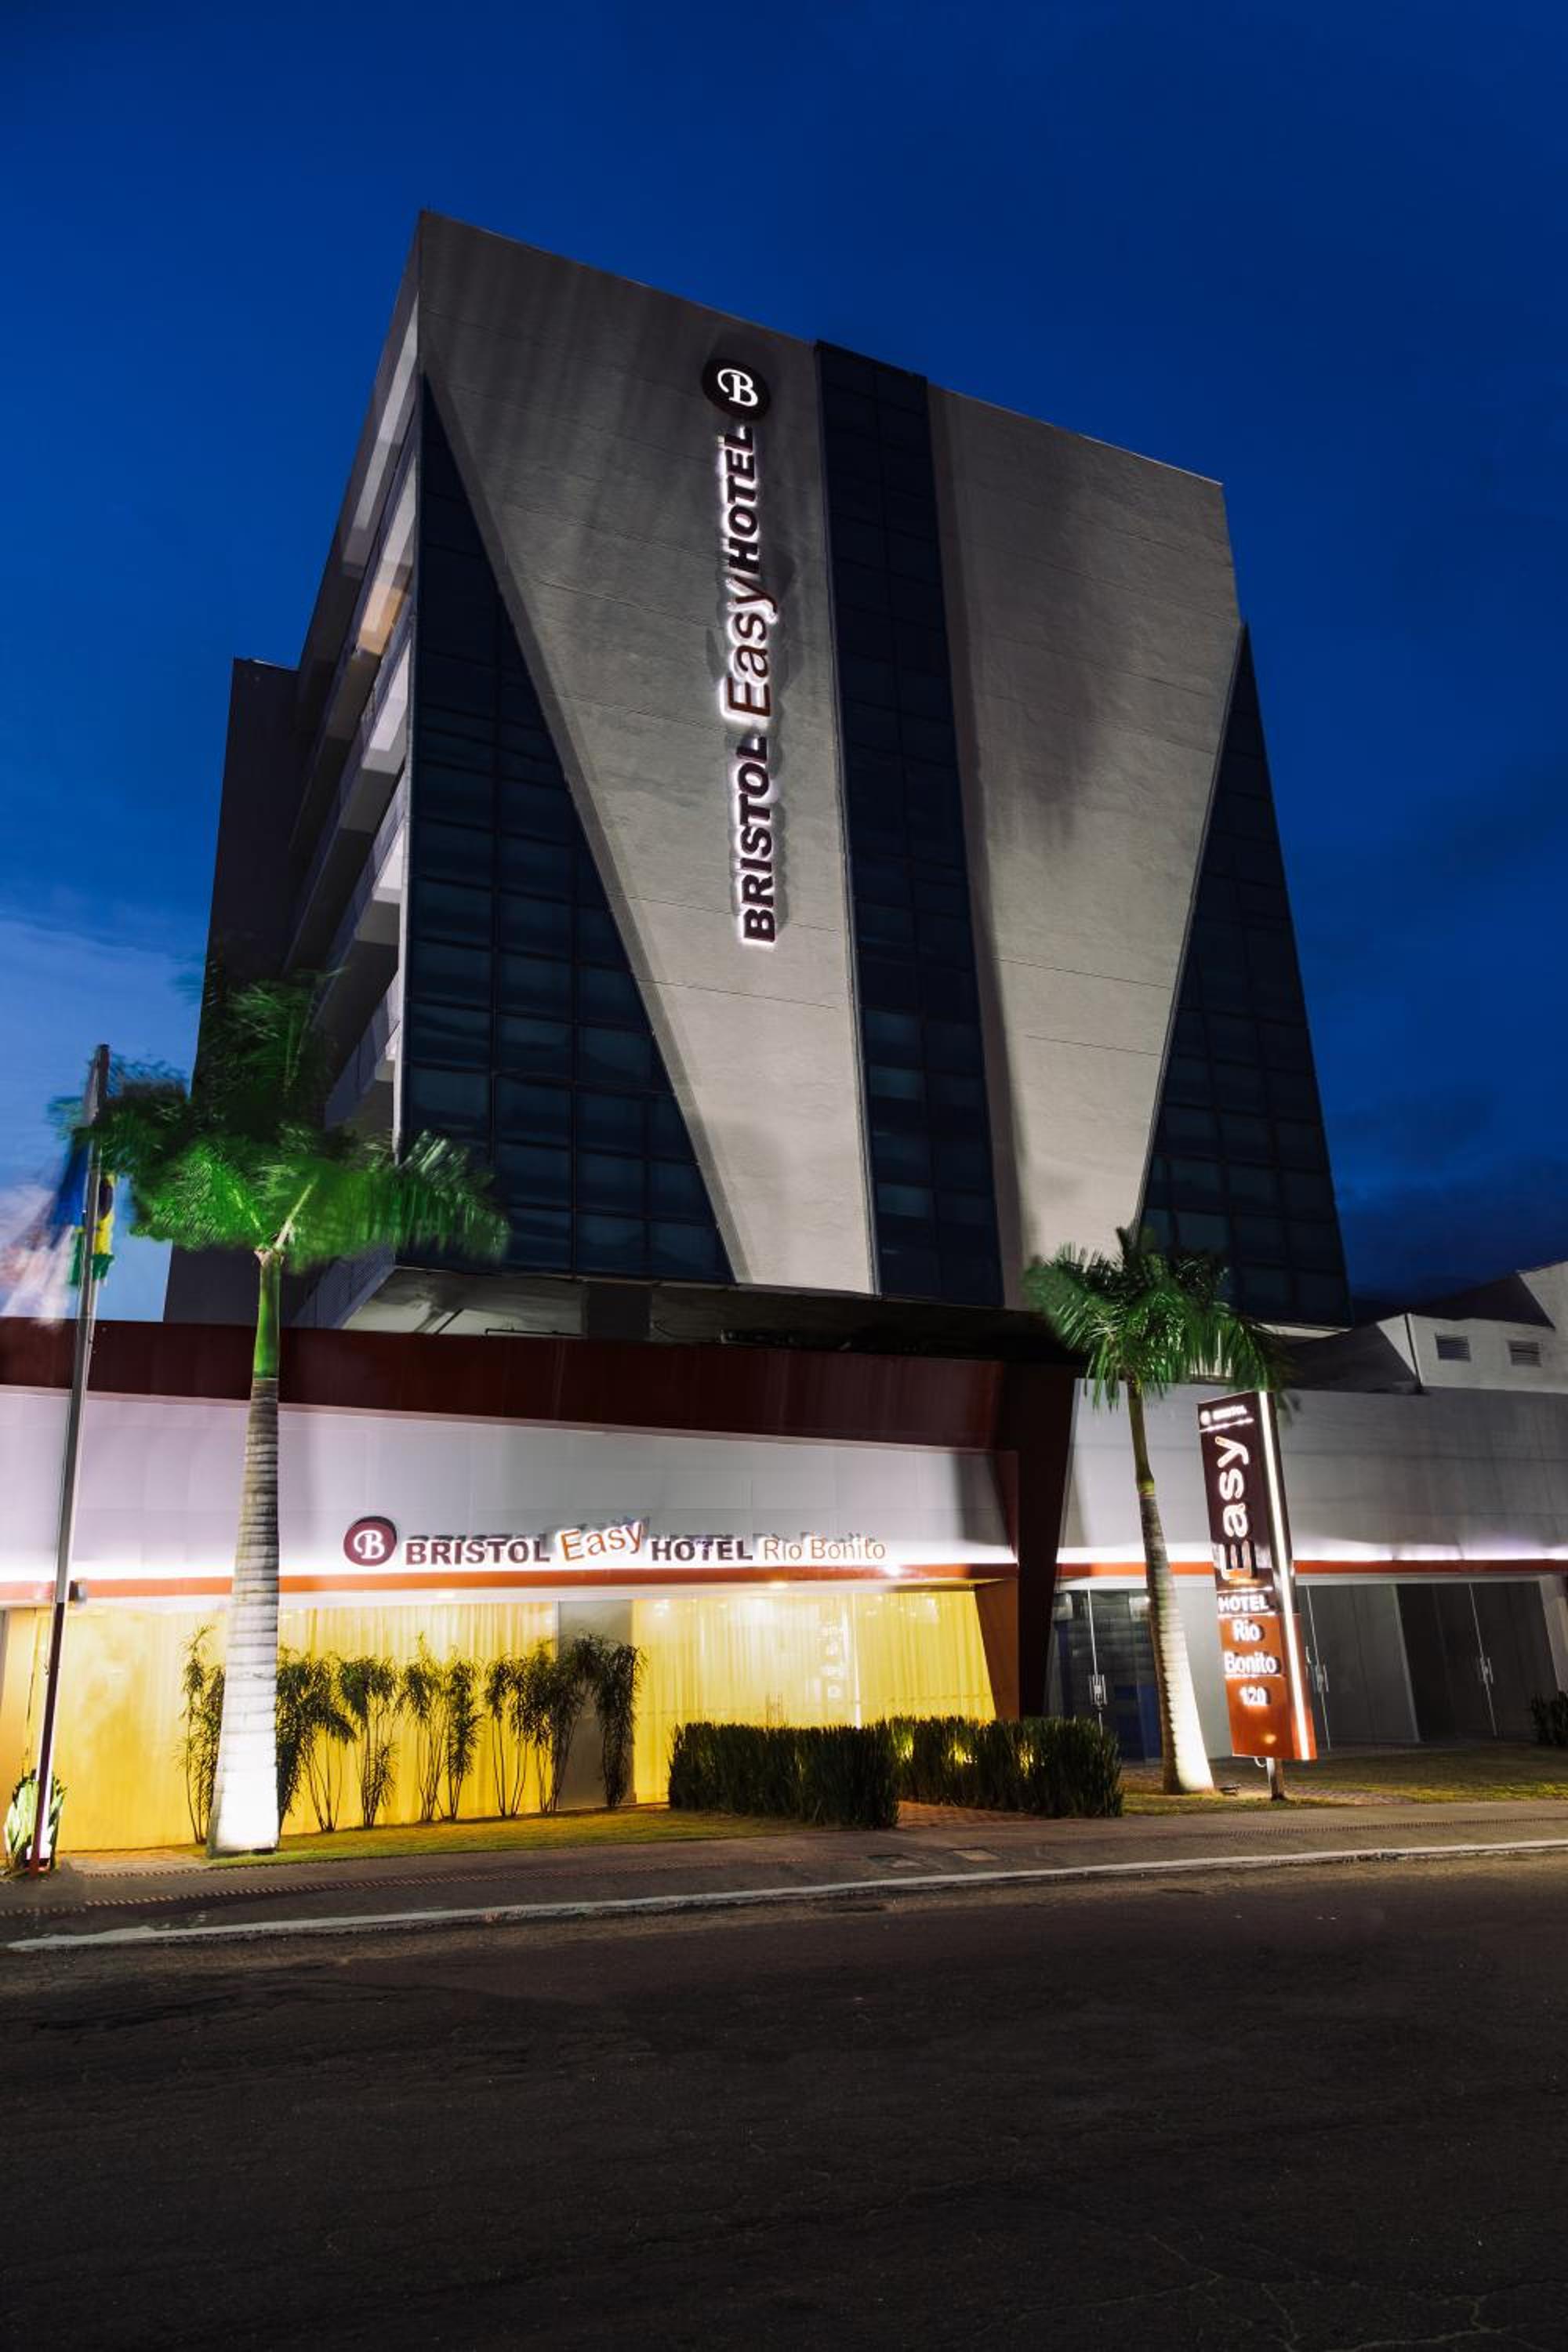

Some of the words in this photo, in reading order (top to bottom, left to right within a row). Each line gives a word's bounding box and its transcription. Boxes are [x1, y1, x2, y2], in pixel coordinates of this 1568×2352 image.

[717, 368, 758, 407] B
[724, 426, 760, 574] HOTEL
[728, 575, 778, 717] Easy
[736, 736, 776, 942] BRISTOL
[1215, 1436, 1251, 1580] Easy
[354, 1530, 385, 1559] B
[405, 1539, 550, 1565] BRISTOL
[561, 1522, 644, 1562] Easy
[652, 1539, 753, 1561] HOTEL
[764, 1538, 802, 1560] Rio
[810, 1537, 886, 1560] Bonito
[1218, 1595, 1269, 1613] HOTEL
[1232, 1619, 1261, 1641] Rio
[1224, 1651, 1277, 1674] Bonito
